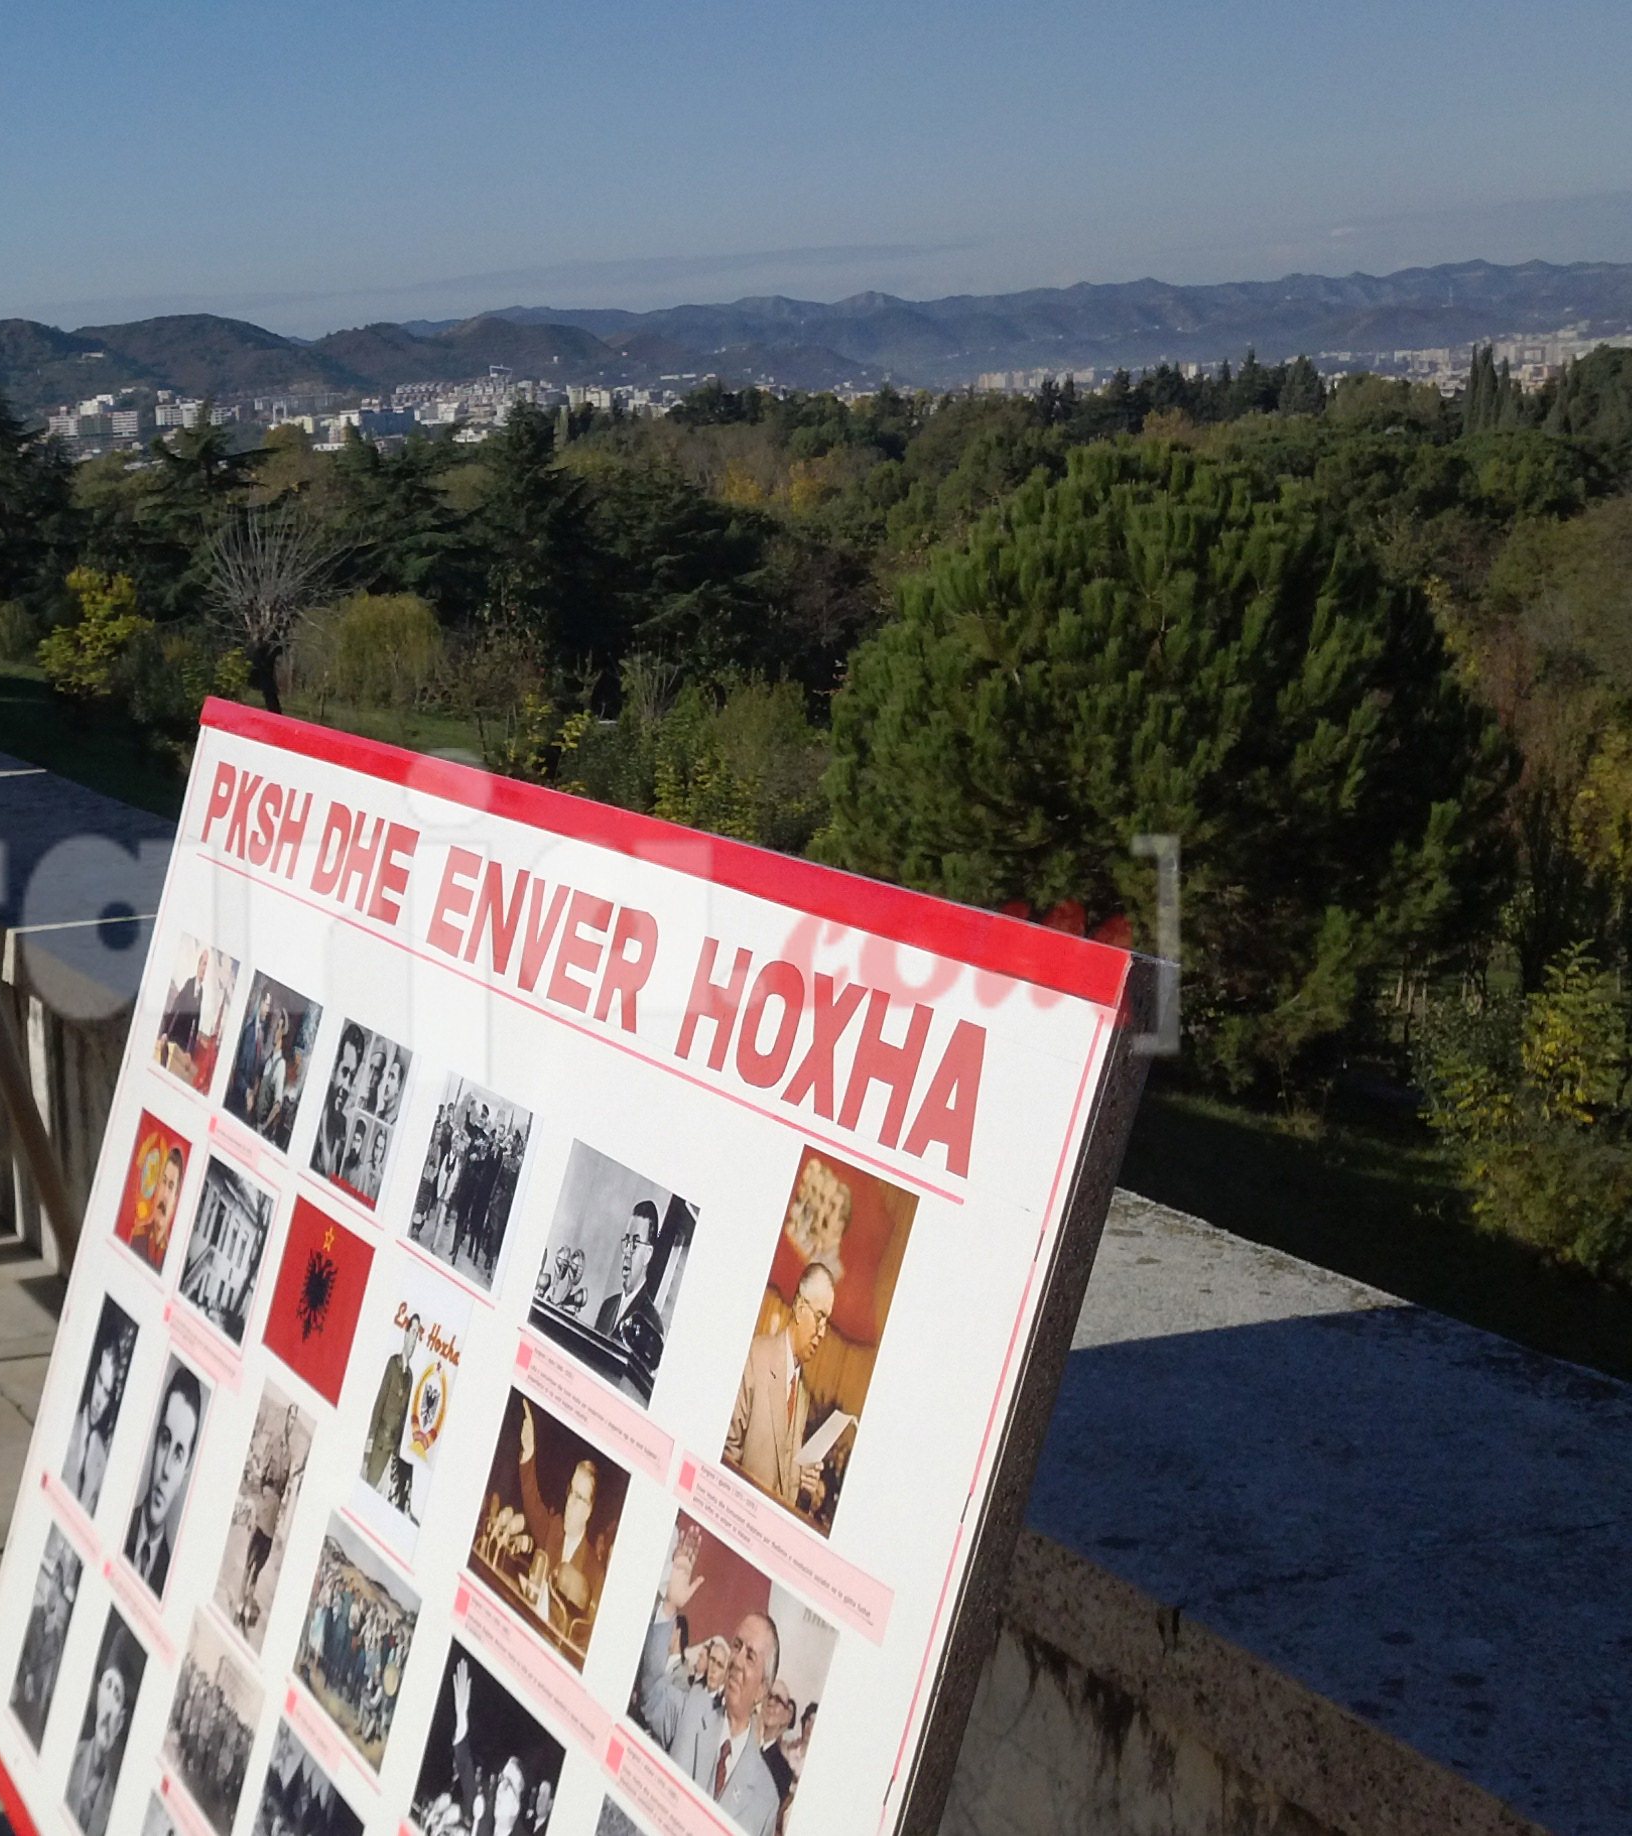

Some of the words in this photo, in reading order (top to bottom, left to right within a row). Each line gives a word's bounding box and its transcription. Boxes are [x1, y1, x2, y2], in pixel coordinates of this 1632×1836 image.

[201, 761, 314, 880] PKSH
[310, 801, 420, 926] DHE
[426, 845, 659, 1034] ENVER
[674, 936, 987, 1178] HOXHA
